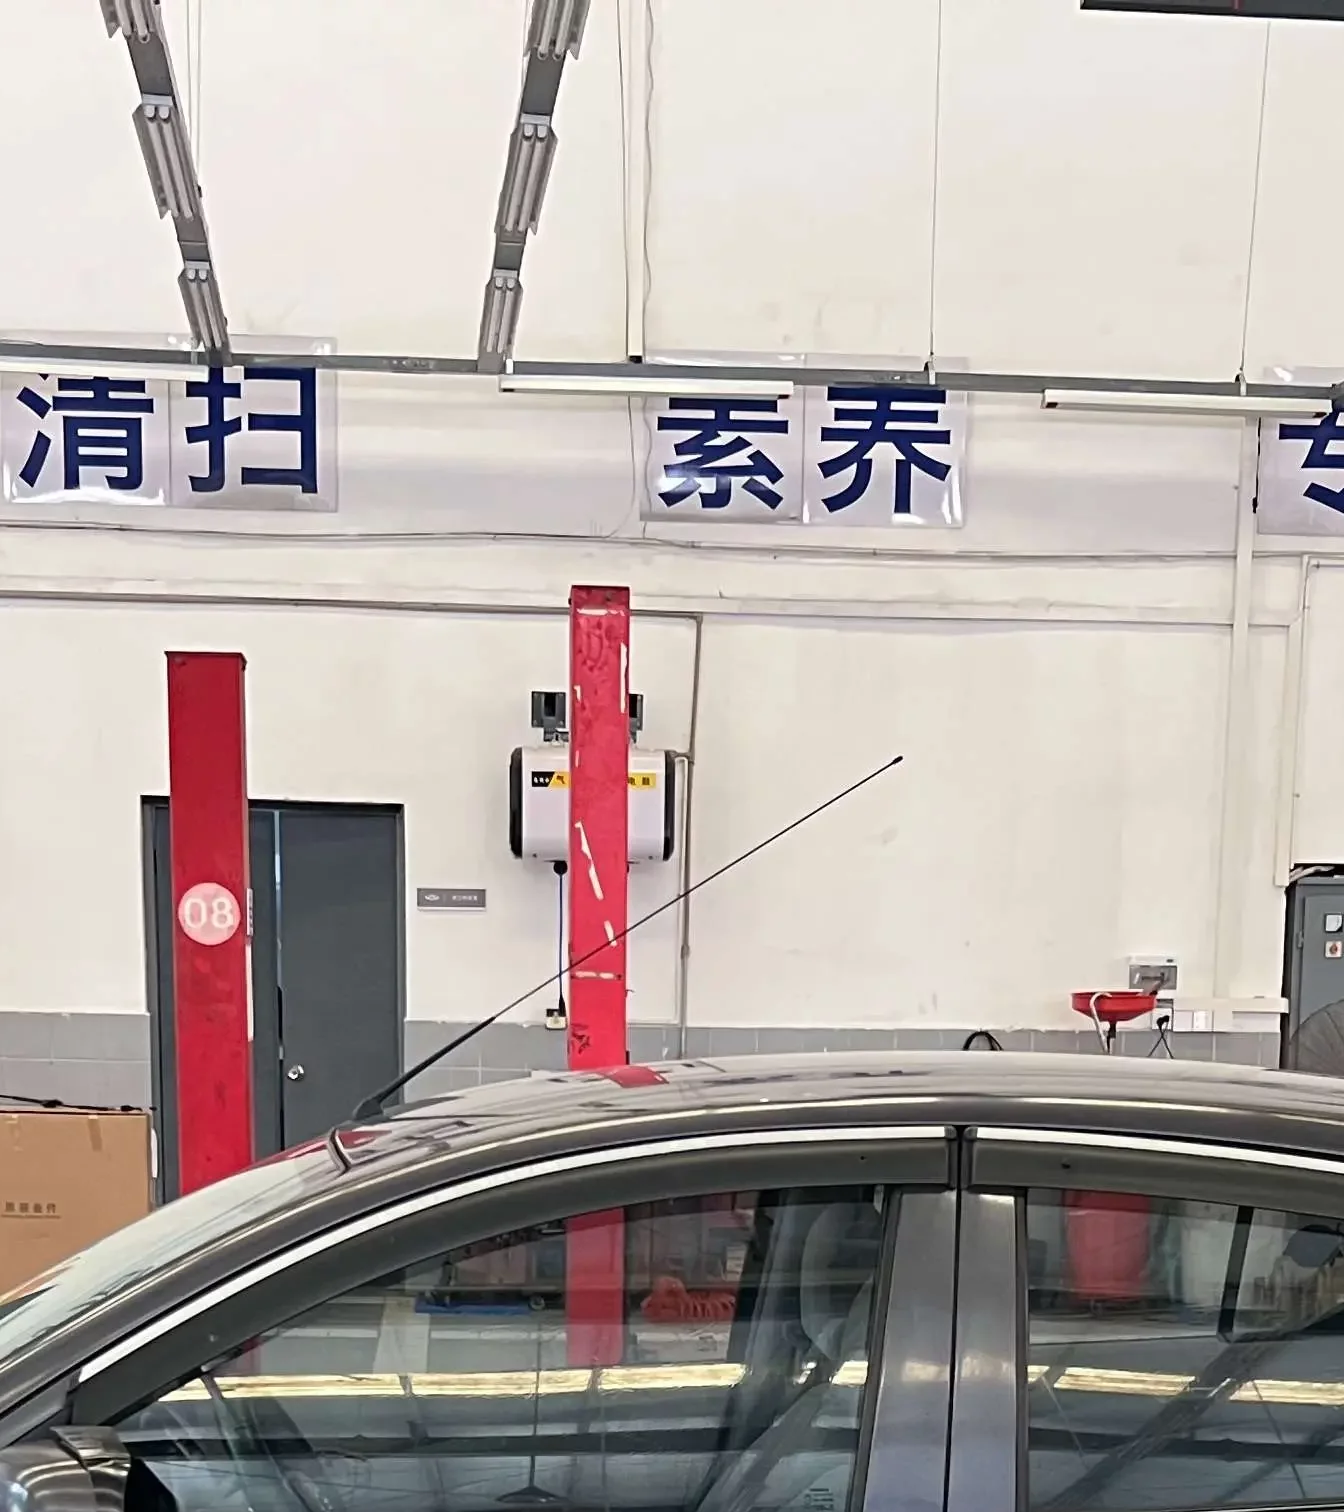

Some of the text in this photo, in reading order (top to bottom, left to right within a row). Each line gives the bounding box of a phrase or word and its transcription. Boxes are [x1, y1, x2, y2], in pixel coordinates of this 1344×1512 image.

[16, 367, 318, 494] 清扫
[657, 385, 952, 514] 素养
[184, 896, 234, 929] 08
